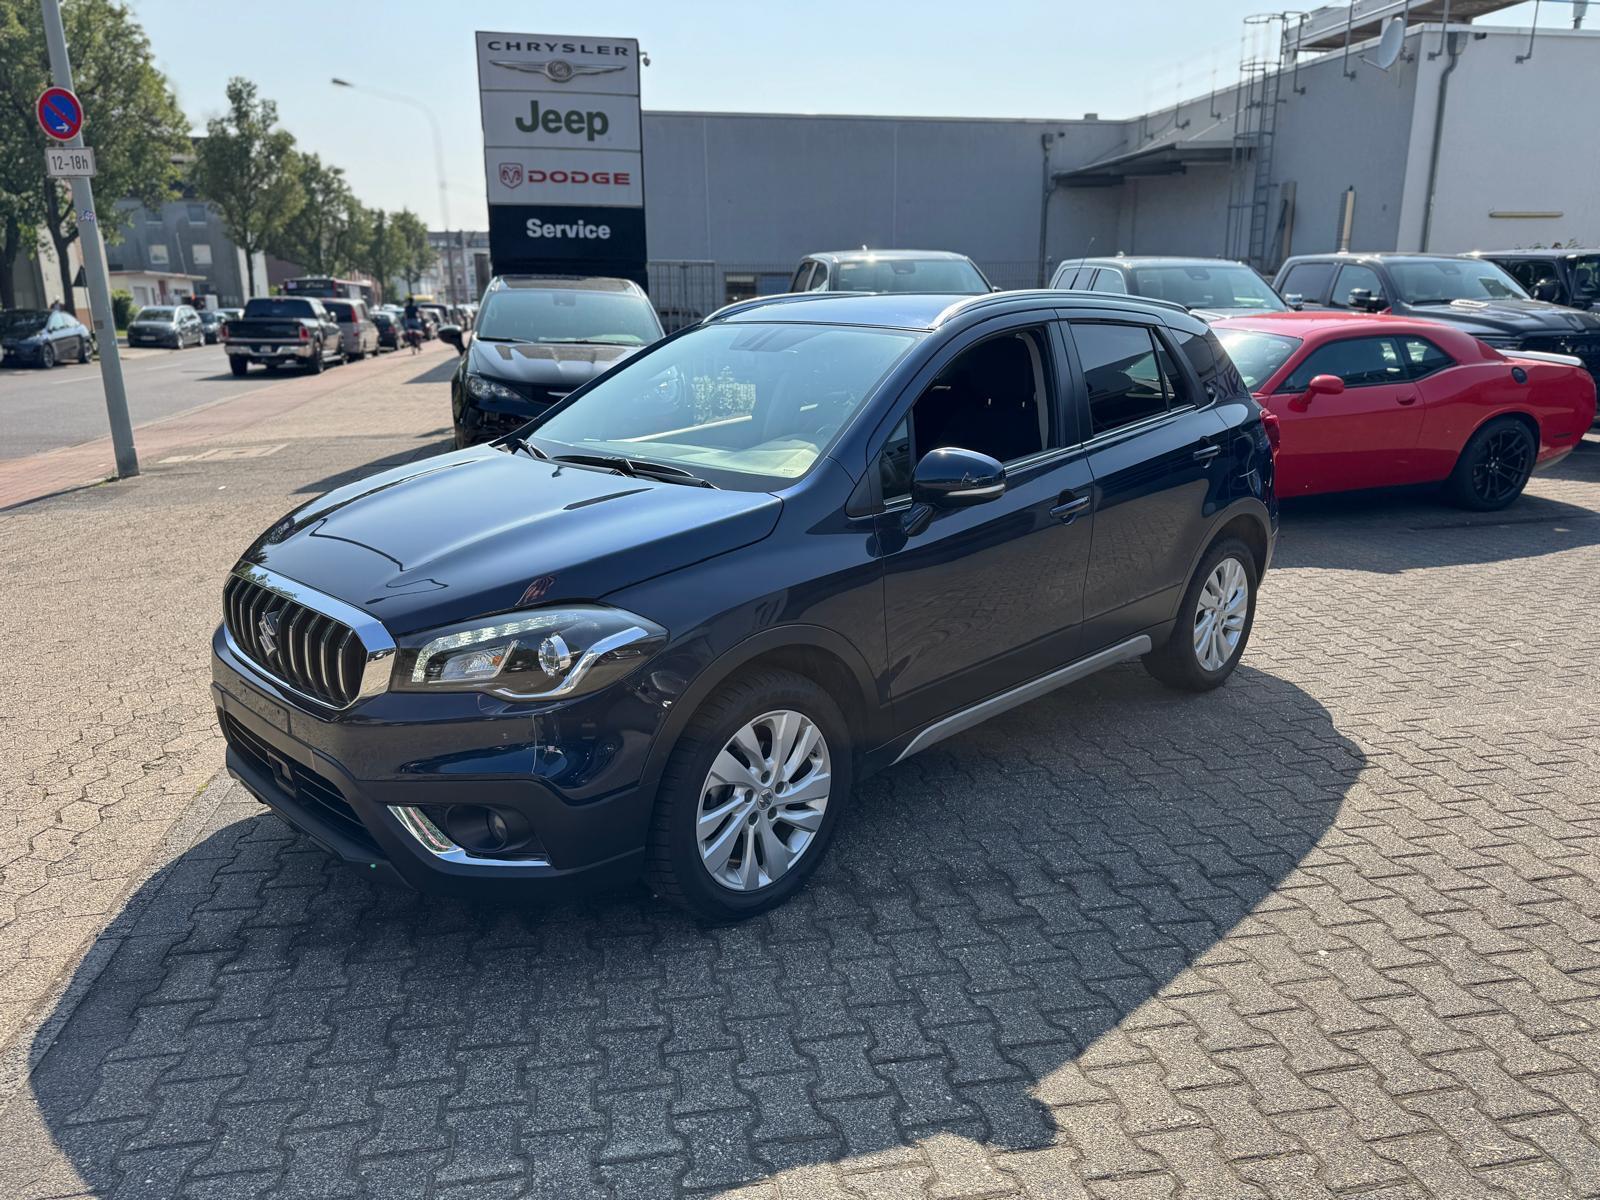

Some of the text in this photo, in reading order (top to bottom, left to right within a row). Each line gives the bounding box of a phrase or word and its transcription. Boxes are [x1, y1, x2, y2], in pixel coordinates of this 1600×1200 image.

[487, 40, 629, 57] CHRYSLER
[515, 100, 609, 141] Jeep
[51, 155, 89, 171] 12-18h
[528, 170, 631, 185] DODGE
[526, 218, 611, 240] Service
